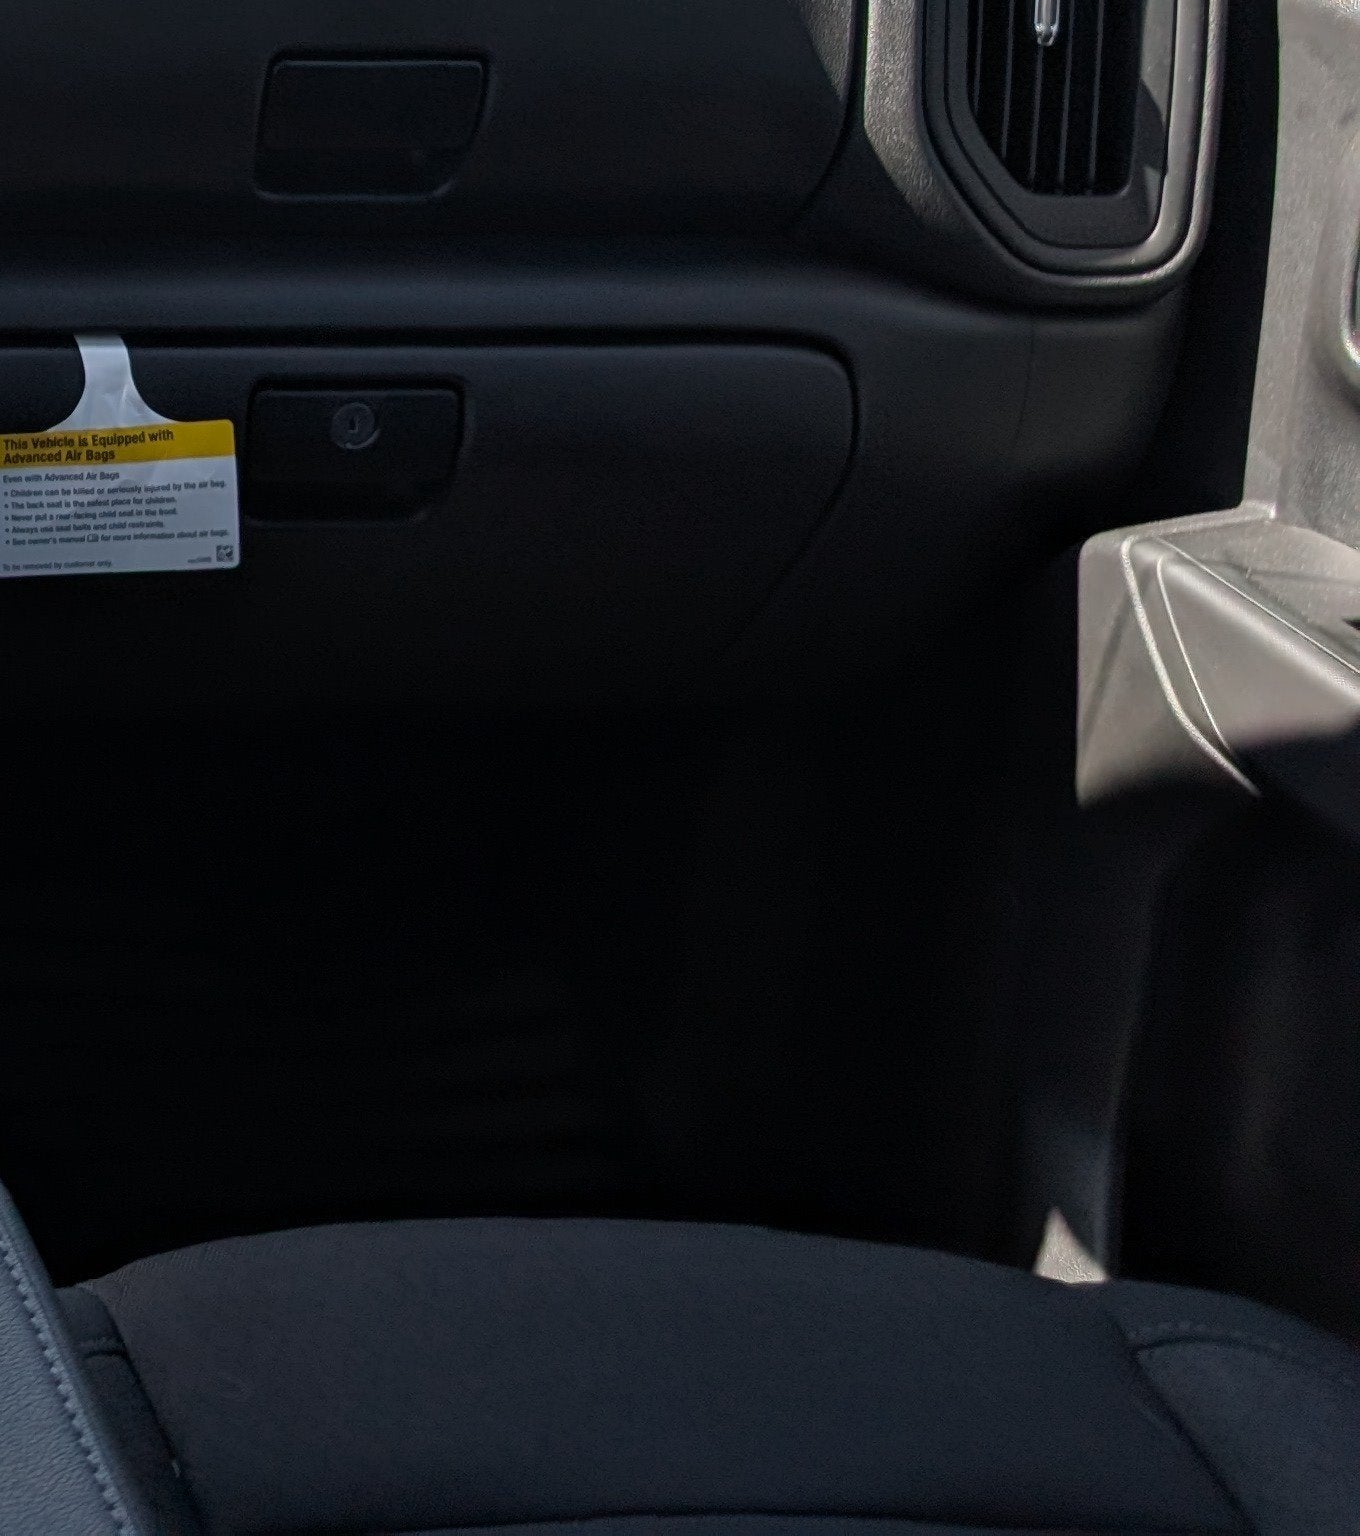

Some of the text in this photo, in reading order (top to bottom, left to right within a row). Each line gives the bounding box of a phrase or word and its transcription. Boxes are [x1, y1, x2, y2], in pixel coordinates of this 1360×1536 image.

[3, 429, 174, 450] This Vehicle is Equipped with
[4, 449, 116, 464] Advanced Air Bags
[2, 474, 23, 483] Even
[44, 472, 84, 482] Advanced
[86, 472, 97, 480] Air
